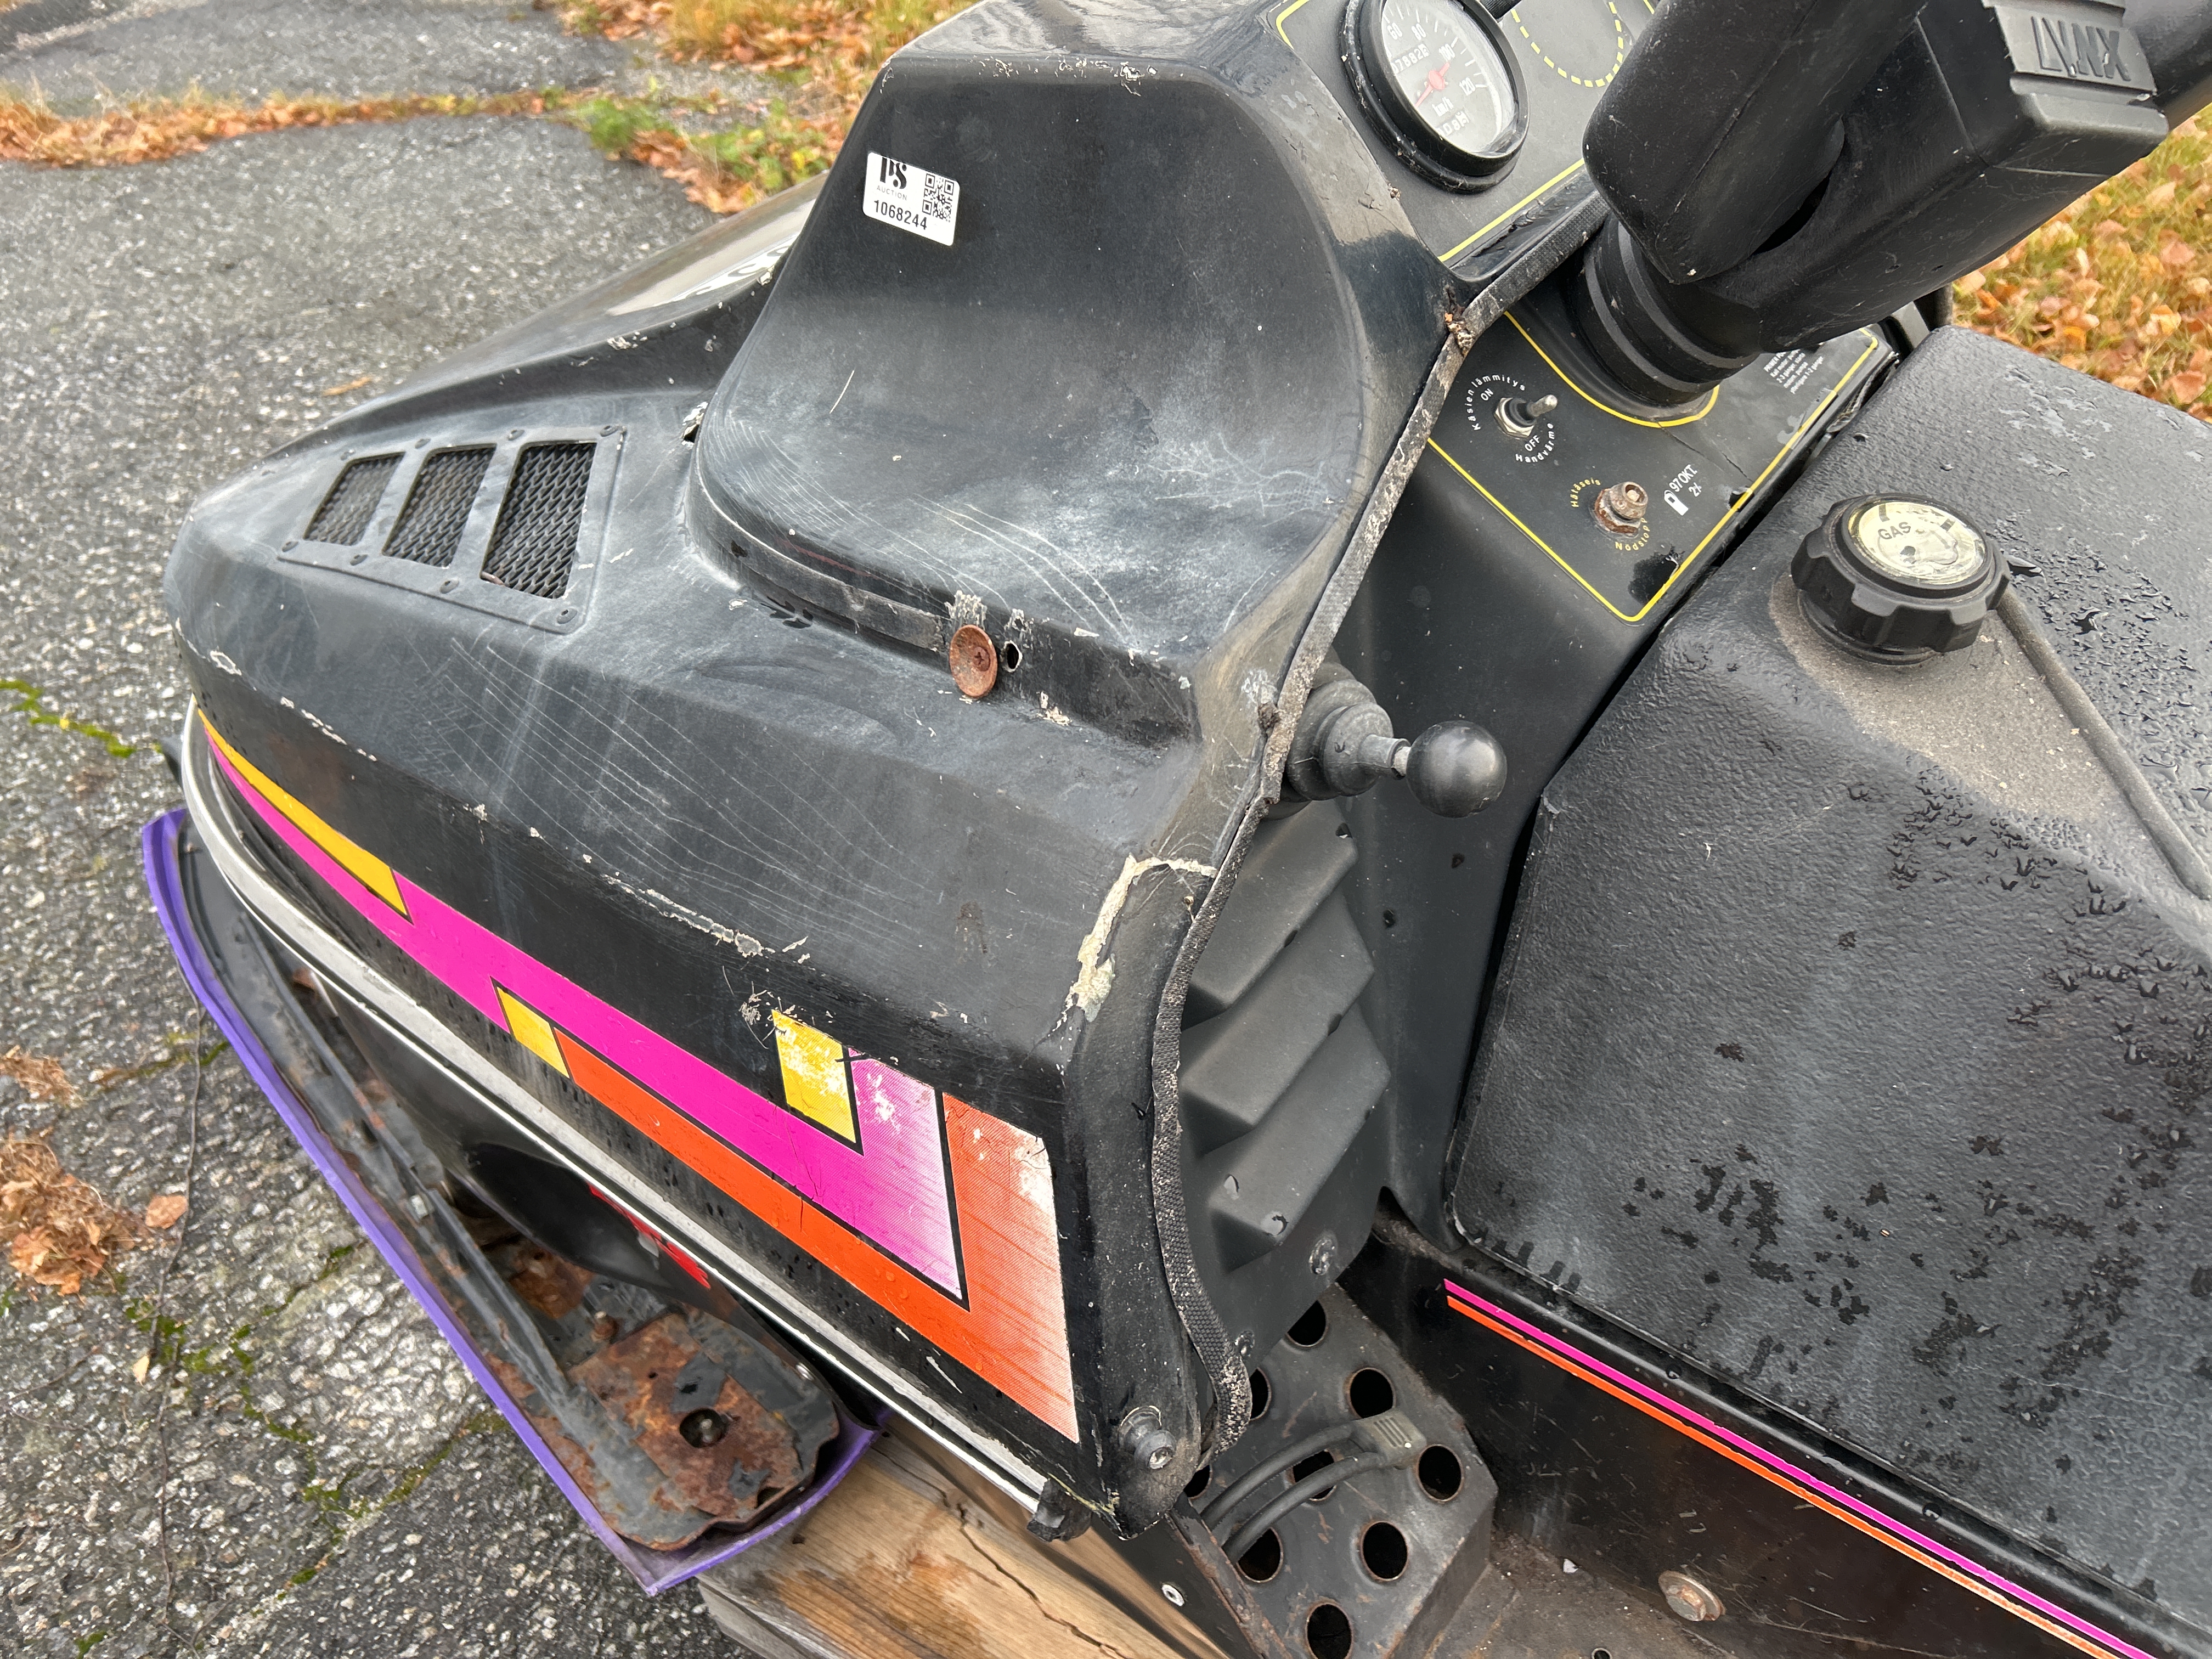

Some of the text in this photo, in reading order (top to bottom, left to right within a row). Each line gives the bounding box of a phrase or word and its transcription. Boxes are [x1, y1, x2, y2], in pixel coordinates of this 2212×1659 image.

[1387, 22, 1403, 40] 60
[1411, 23, 1426, 41] 80
[1438, 43, 1455, 61] 100
[2031, 16, 2131, 81] LYNX
[1459, 77, 1476, 96] 120
[1431, 96, 1454, 117] km/h
[877, 185, 907, 201] AUCTION
[874, 200, 927, 230] 1068244
[1464, 374, 1525, 431] Käsien lämmitys
[1481, 388, 1494, 401] ON
[1515, 423, 1555, 463] Handvärme
[1525, 435, 1541, 452] OFF
[1570, 477, 1601, 507] Hätäseis
[1877, 522, 1911, 540] GAS
